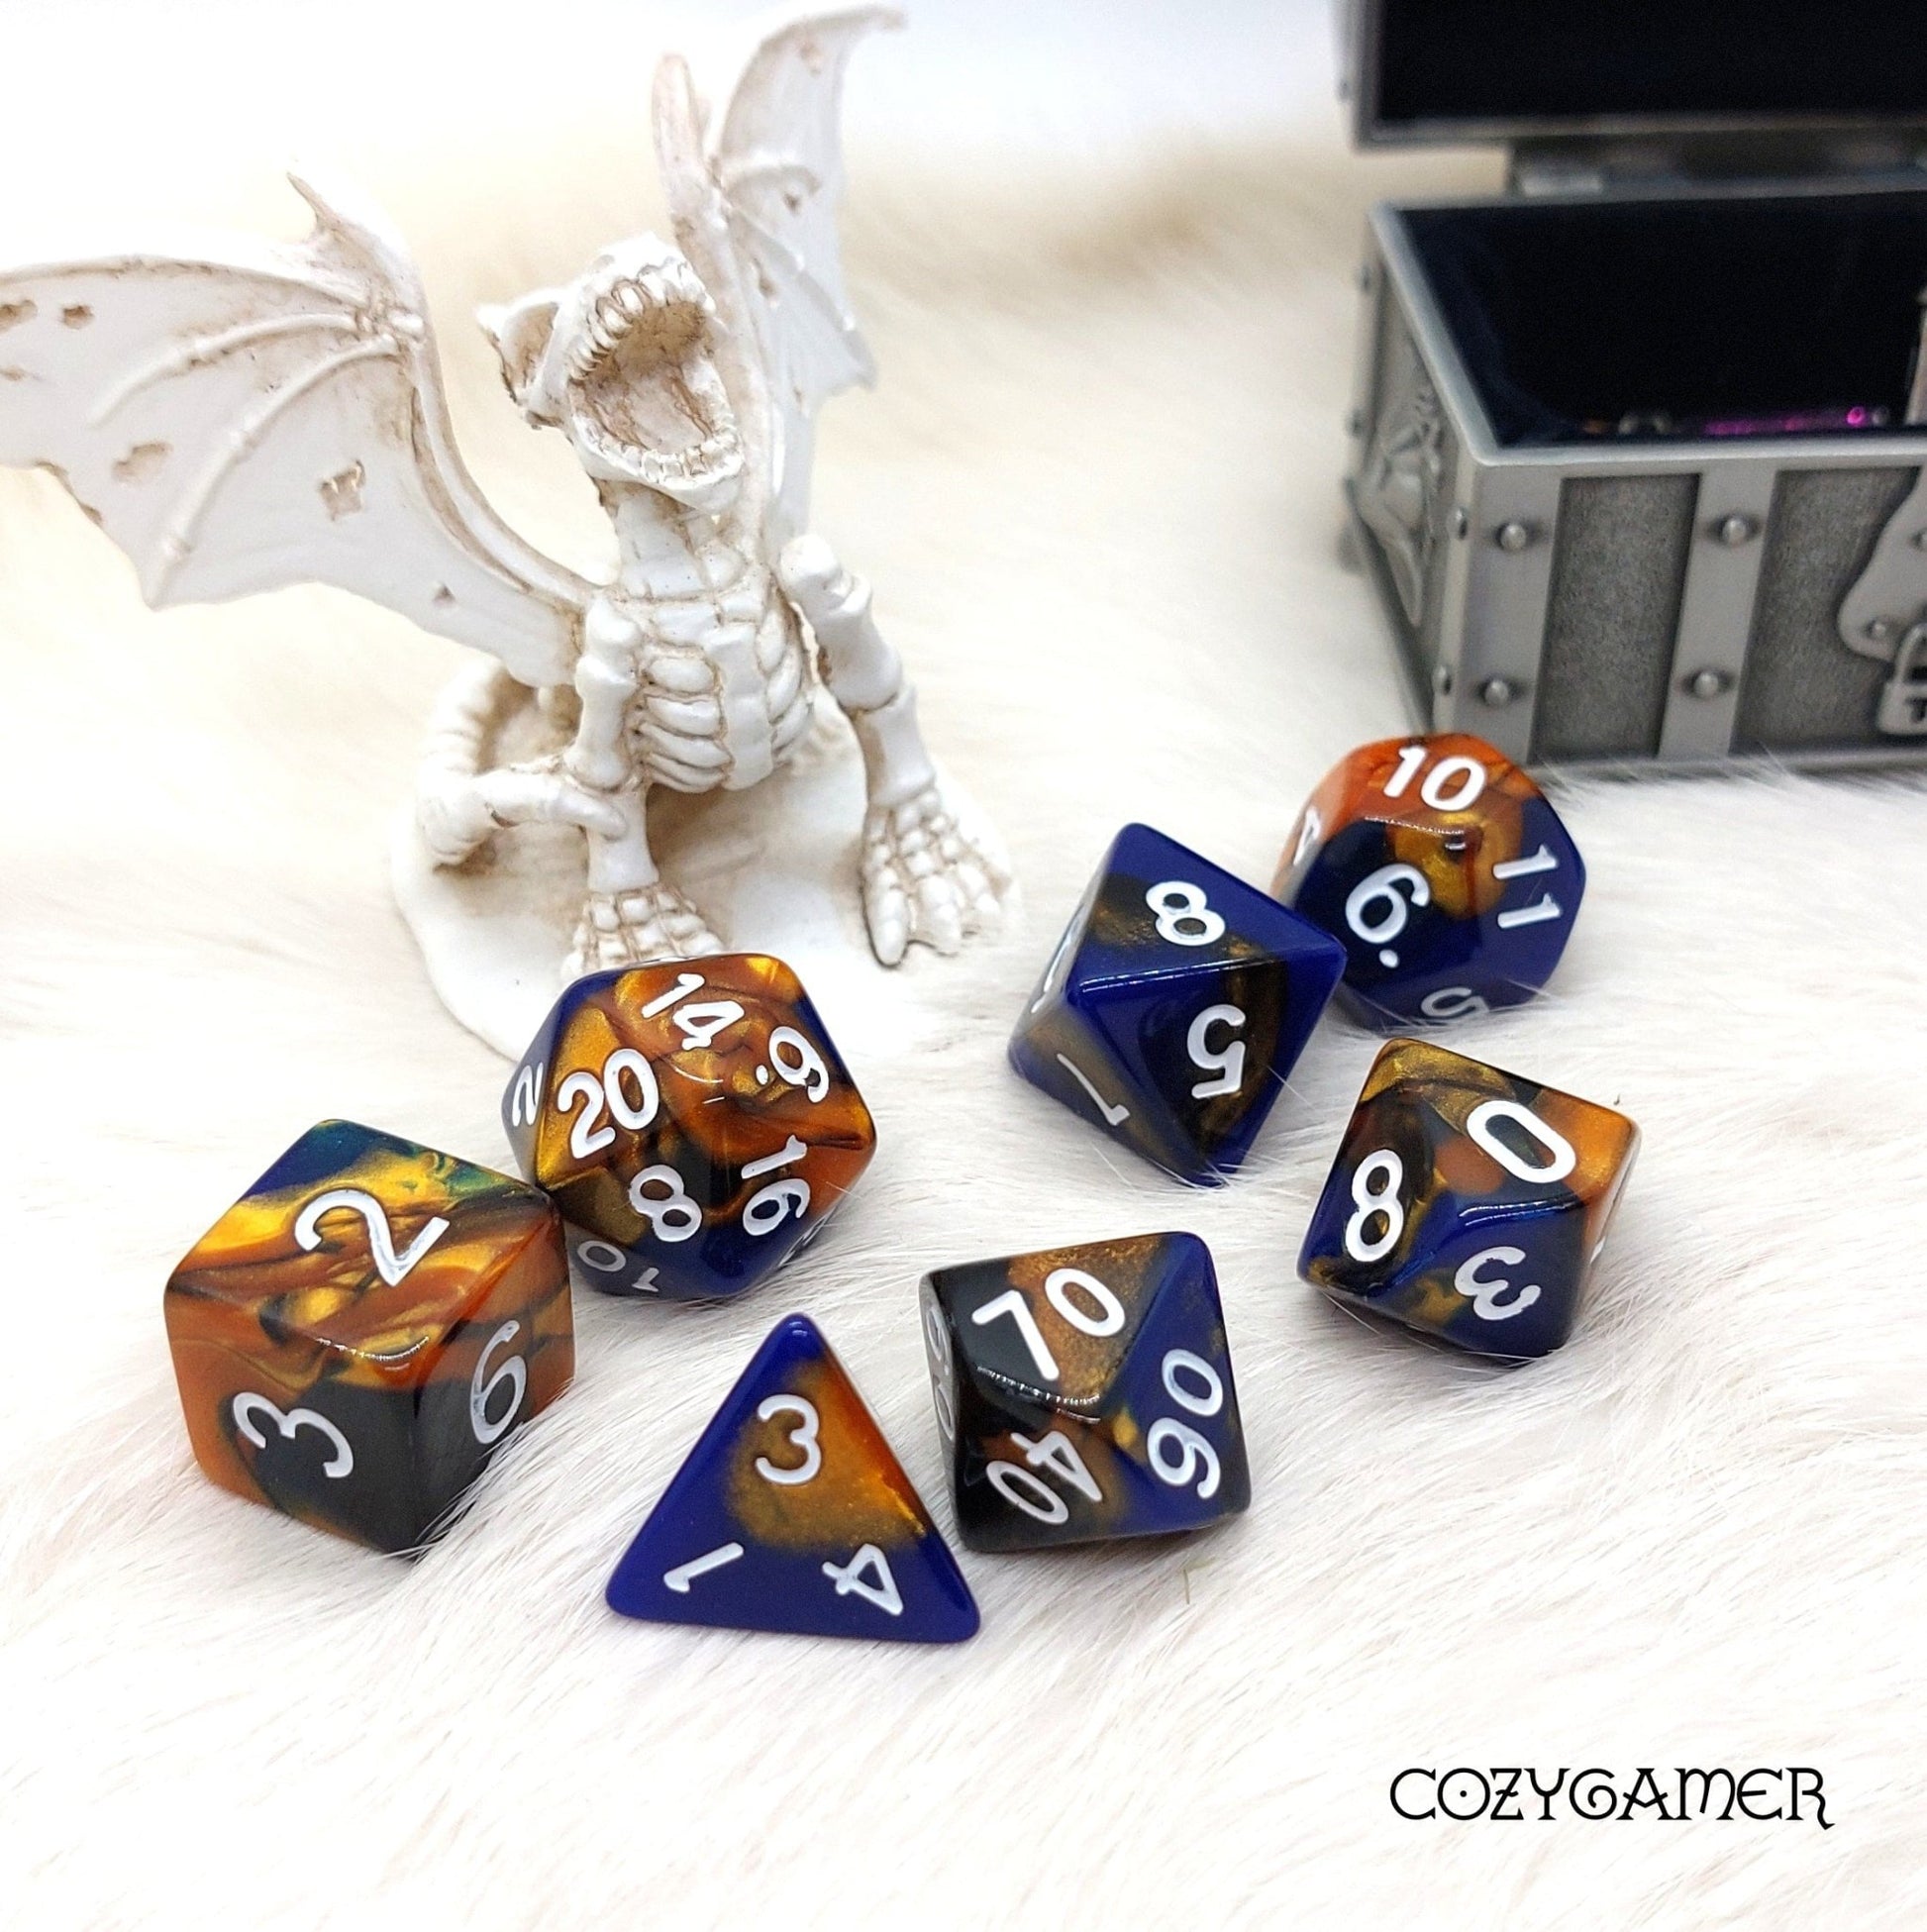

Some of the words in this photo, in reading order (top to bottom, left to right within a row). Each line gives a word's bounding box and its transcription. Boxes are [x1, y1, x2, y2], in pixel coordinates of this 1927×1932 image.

[1383, 747, 1486, 811] 10
[1146, 881, 1226, 946] 8
[1493, 844, 1562, 929] 11
[642, 973, 745, 1051] 14
[1187, 1004, 1246, 1099] 5
[558, 1049, 659, 1159] 20
[1467, 1100, 1576, 1183] 0
[628, 1165, 703, 1243] 8
[741, 1135, 811, 1237] 16
[1345, 1150, 1404, 1262] 8
[295, 1189, 450, 1286] 2
[576, 1240, 659, 1293] 10
[971, 1268, 1126, 1381] 70
[1455, 1246, 1541, 1321] 3
[470, 1320, 527, 1444] 6
[1147, 1349, 1224, 1499] 90
[233, 1391, 354, 1478] 3
[756, 1394, 821, 1485] 3
[986, 1430, 1102, 1524] 40
[663, 1542, 744, 1593] 1
[822, 1543, 903, 1616] 4
